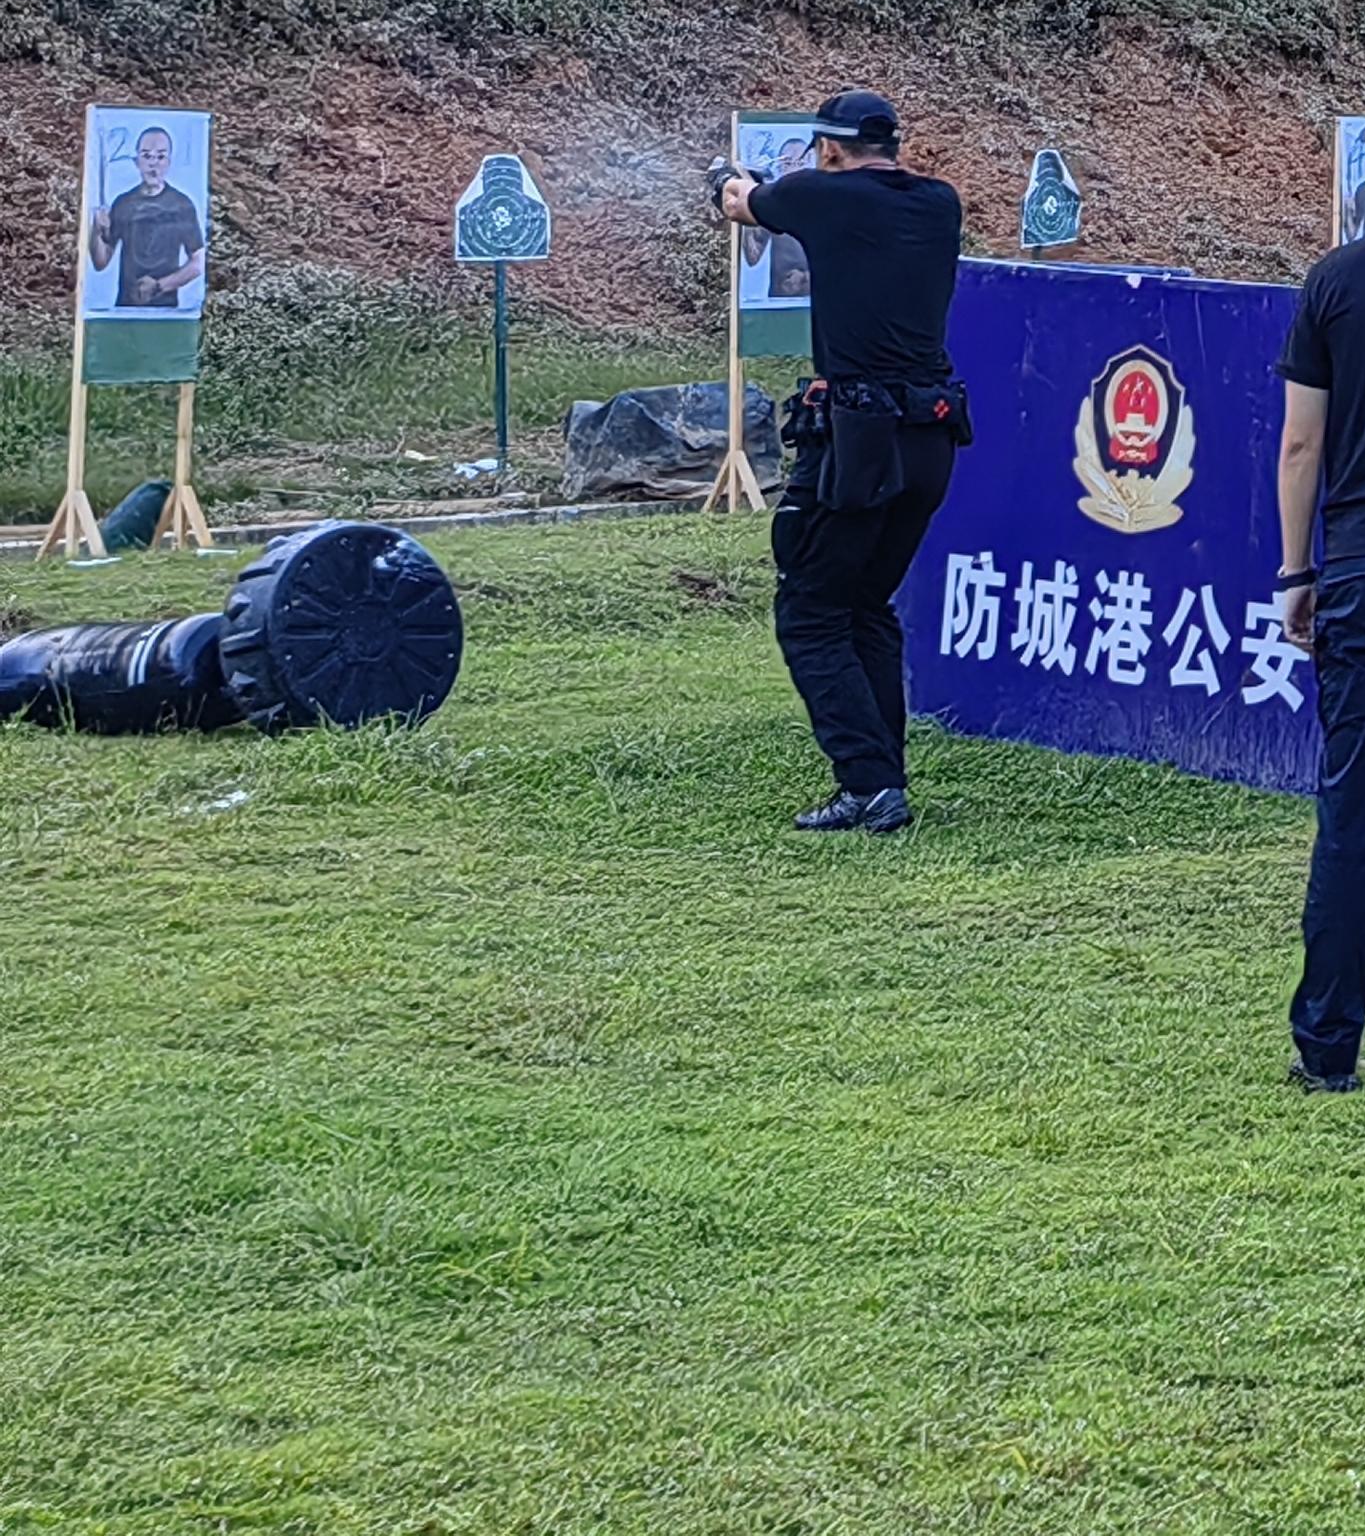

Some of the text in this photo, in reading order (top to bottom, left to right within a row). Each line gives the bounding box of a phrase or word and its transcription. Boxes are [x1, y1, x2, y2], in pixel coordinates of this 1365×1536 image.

[940, 550, 1311, 713] 防城港公安
